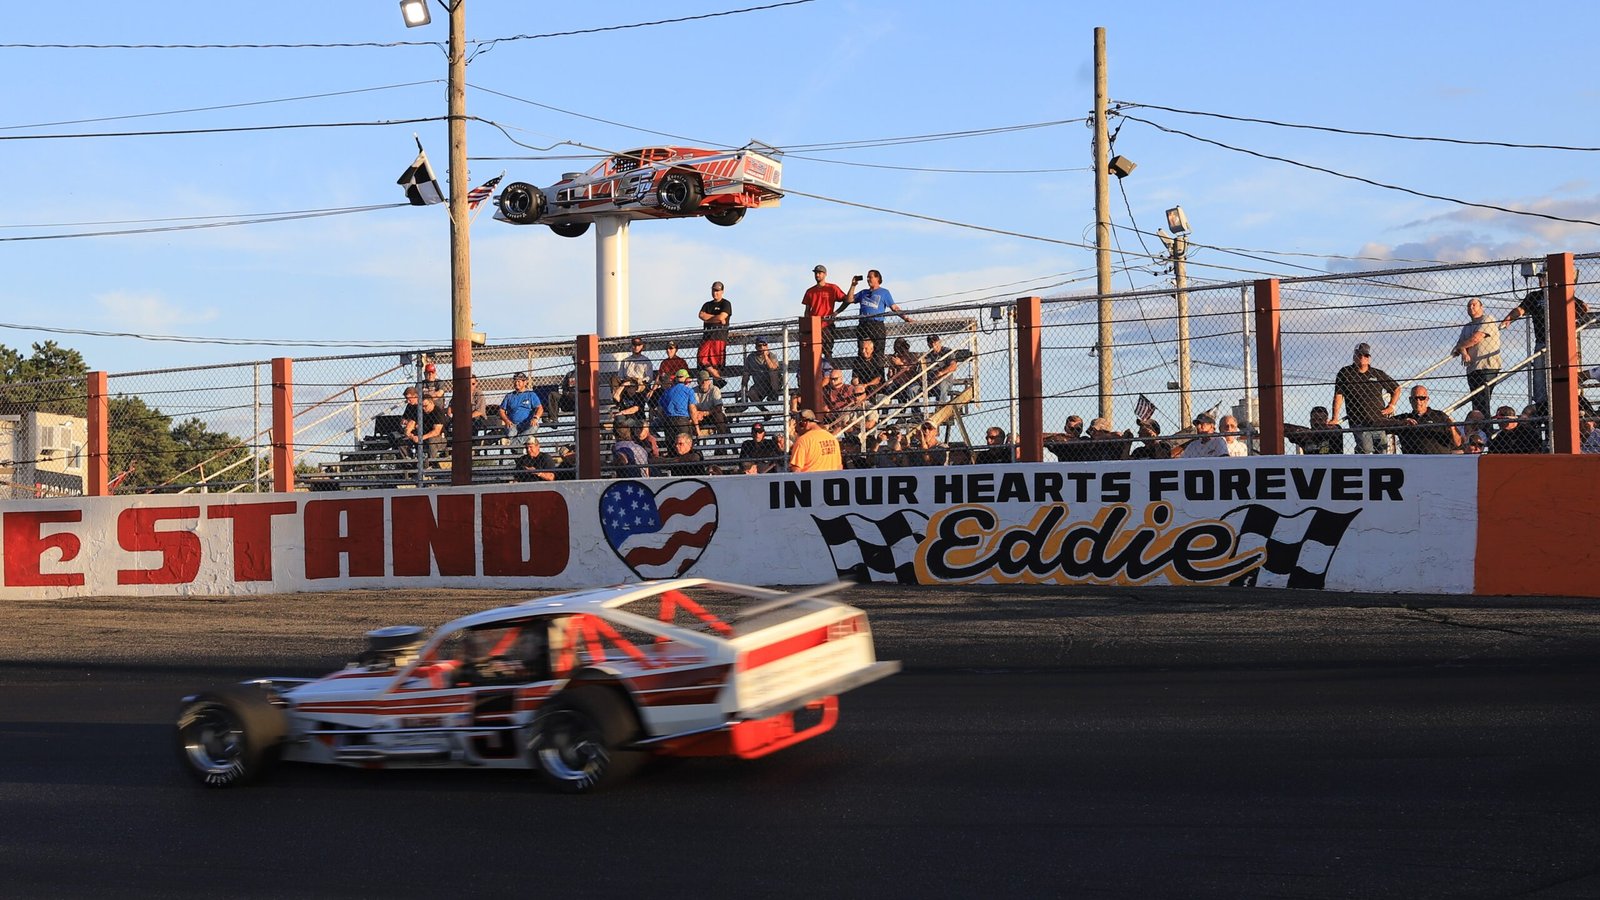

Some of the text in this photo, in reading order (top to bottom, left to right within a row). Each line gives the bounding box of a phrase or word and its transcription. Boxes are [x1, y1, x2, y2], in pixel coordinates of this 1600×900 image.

[819, 439, 836, 448] TRACK
[821, 447, 836, 456] STAFF
[770, 467, 1405, 509] IN OUR HEARTS FOREVER
[116, 490, 570, 585] STAND
[921, 502, 1266, 583] Eddie
